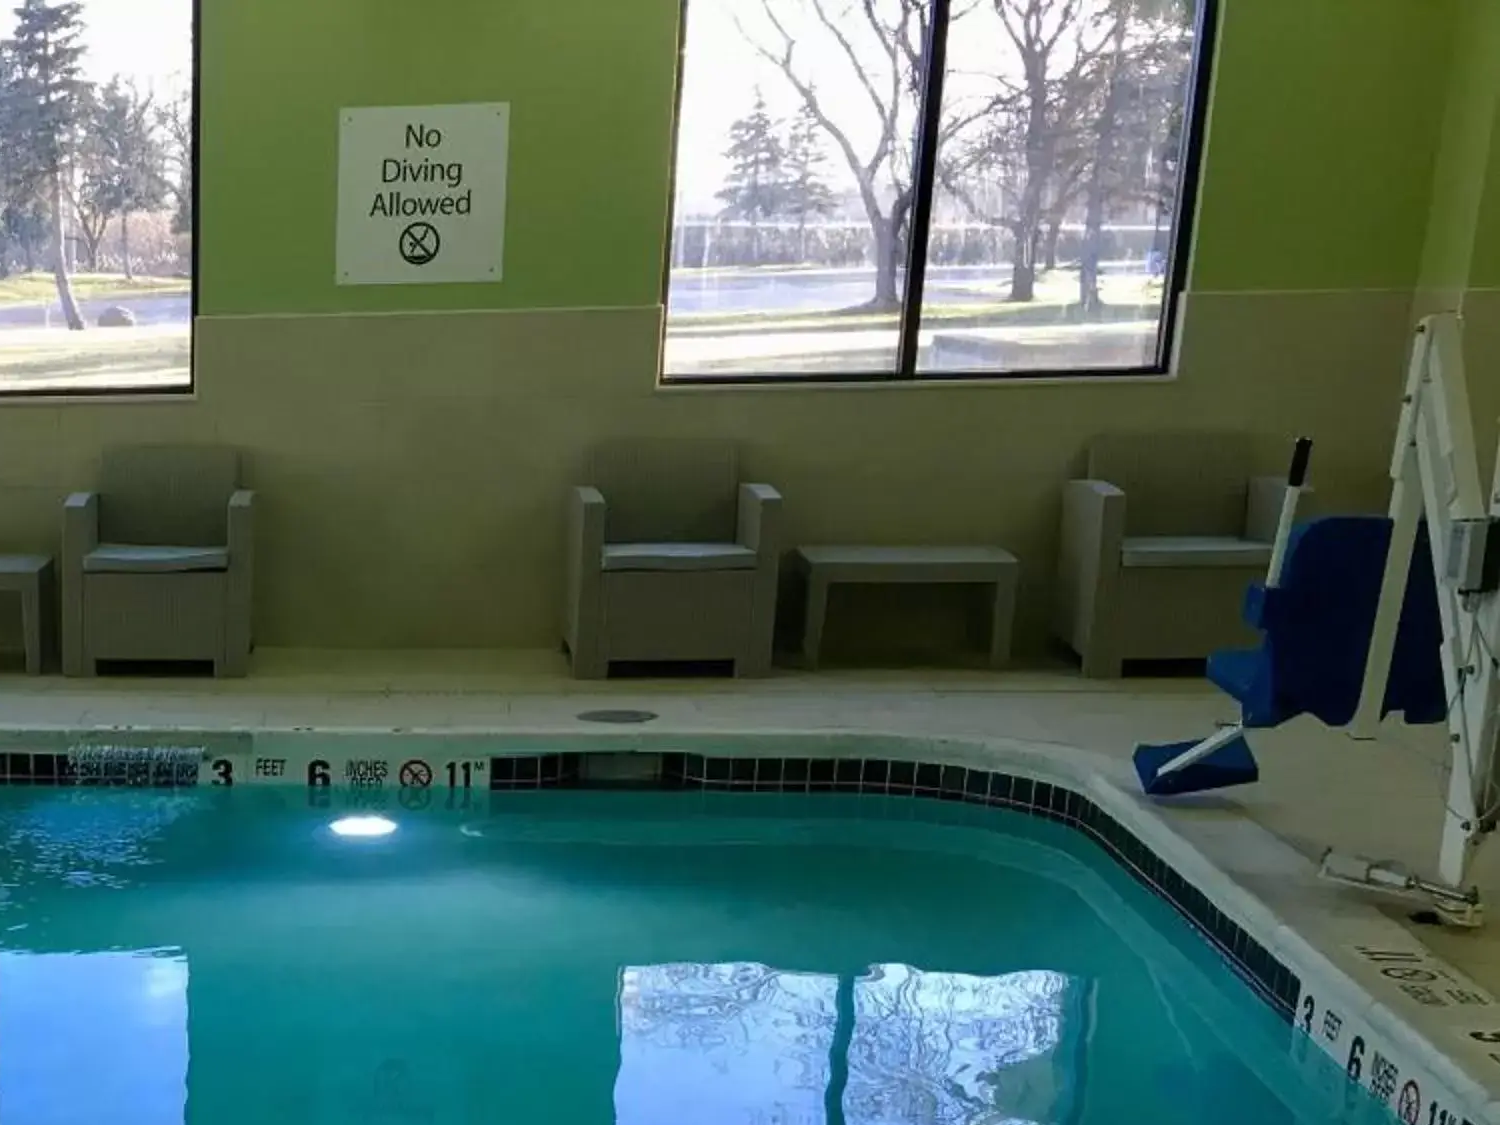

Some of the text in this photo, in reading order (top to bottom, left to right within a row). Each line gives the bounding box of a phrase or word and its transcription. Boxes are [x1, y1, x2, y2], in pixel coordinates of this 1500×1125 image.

[405, 123, 442, 148] No
[381, 158, 463, 188] Diving
[369, 189, 472, 217] Allowed
[211, 759, 233, 786] 3
[255, 758, 287, 776] FEET
[308, 759, 330, 787] 6
[345, 760, 388, 777] INCHES
[1303, 995, 1315, 1034] 3
[1347, 1036, 1365, 1081] 6
